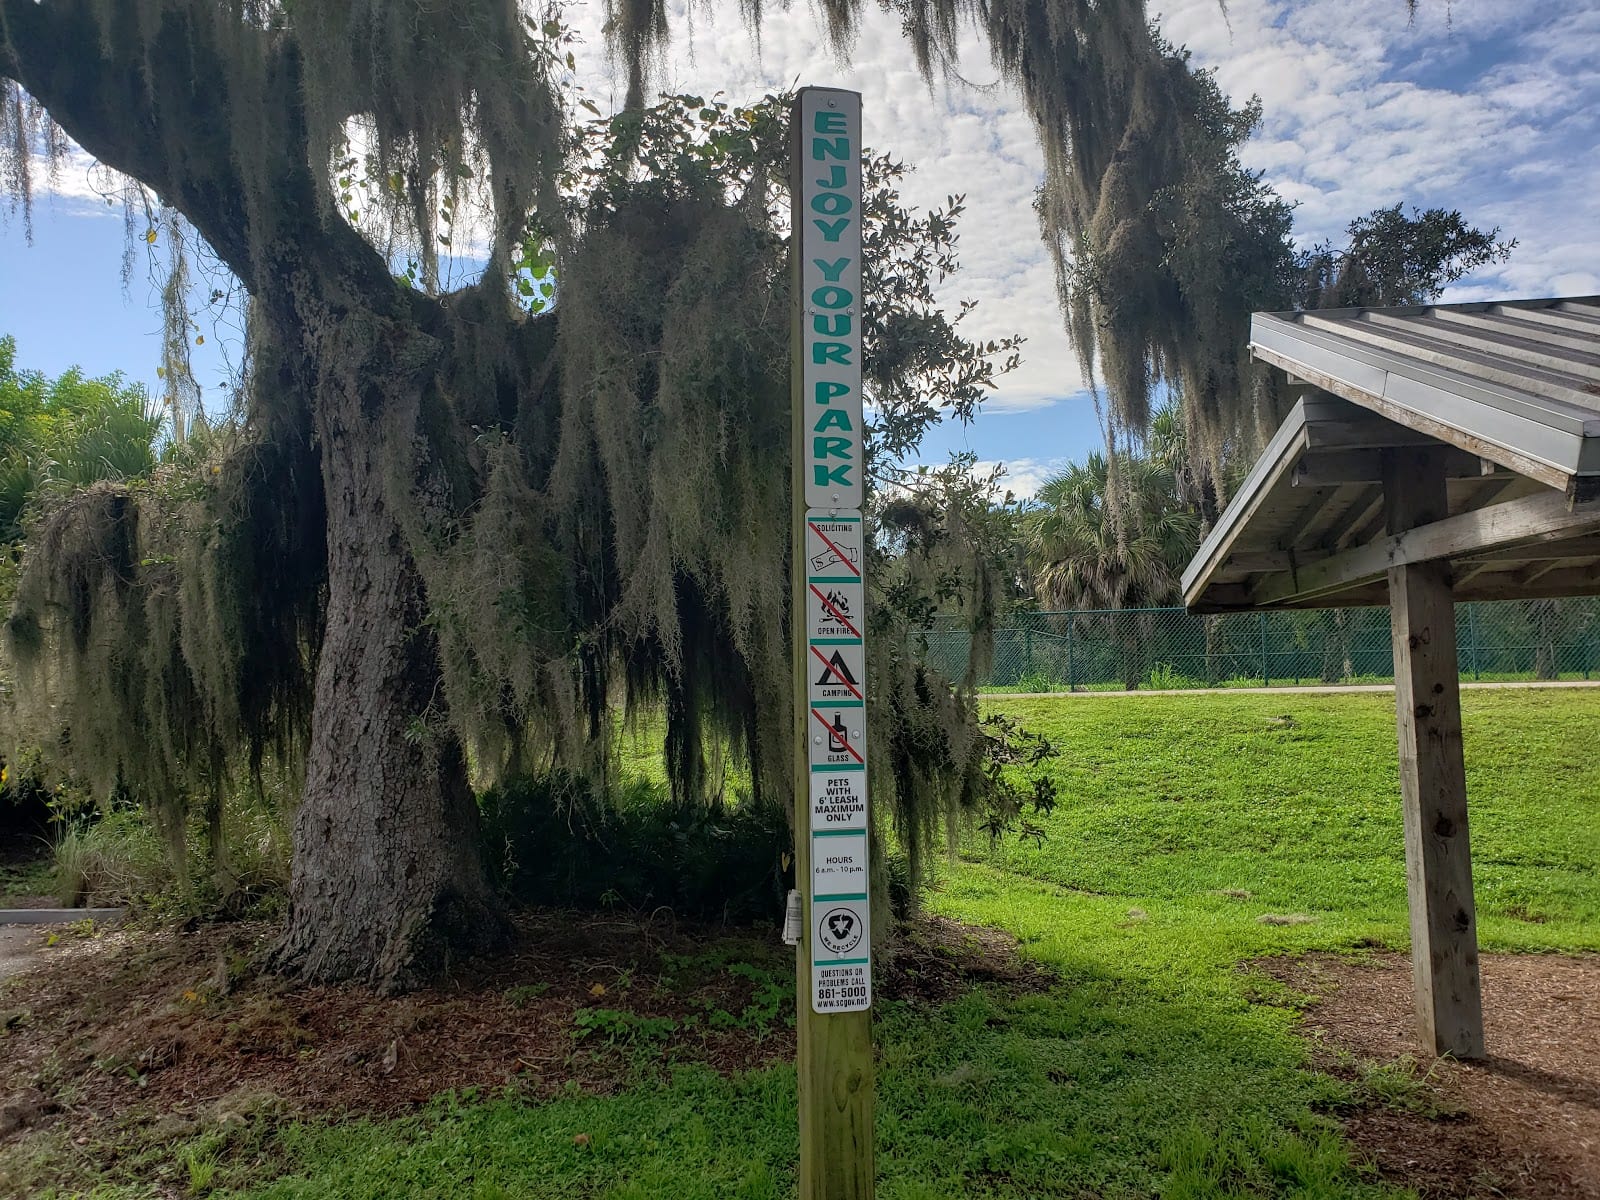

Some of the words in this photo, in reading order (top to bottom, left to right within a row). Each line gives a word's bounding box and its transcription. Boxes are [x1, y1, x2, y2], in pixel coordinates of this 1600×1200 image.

[811, 111, 853, 242] ENJOY
[812, 258, 853, 366] YOUR
[814, 382, 853, 487] PARK
[817, 524, 852, 532] SOLICITING
[817, 627, 835, 635] OPEN
[822, 689, 852, 697] CAMPING
[827, 754, 849, 762] GLASS
[827, 778, 849, 787] PETS
[826, 787, 851, 796] WITH
[829, 795, 858, 804] LEASH
[815, 803, 864, 814] MAXIMUM
[826, 813, 852, 822] ONLY
[826, 856, 853, 864] HOURS
[849, 865, 864, 874] p.m.
[823, 936, 832, 946] WE
[832, 935, 859, 951] RECYCLE
[820, 968, 853, 978] QUESTIONS
[855, 967, 863, 976] OR
[818, 978, 849, 987] PROBLEMS
[851, 977, 866, 986] CALL
[818, 986, 866, 999] 861-5000
